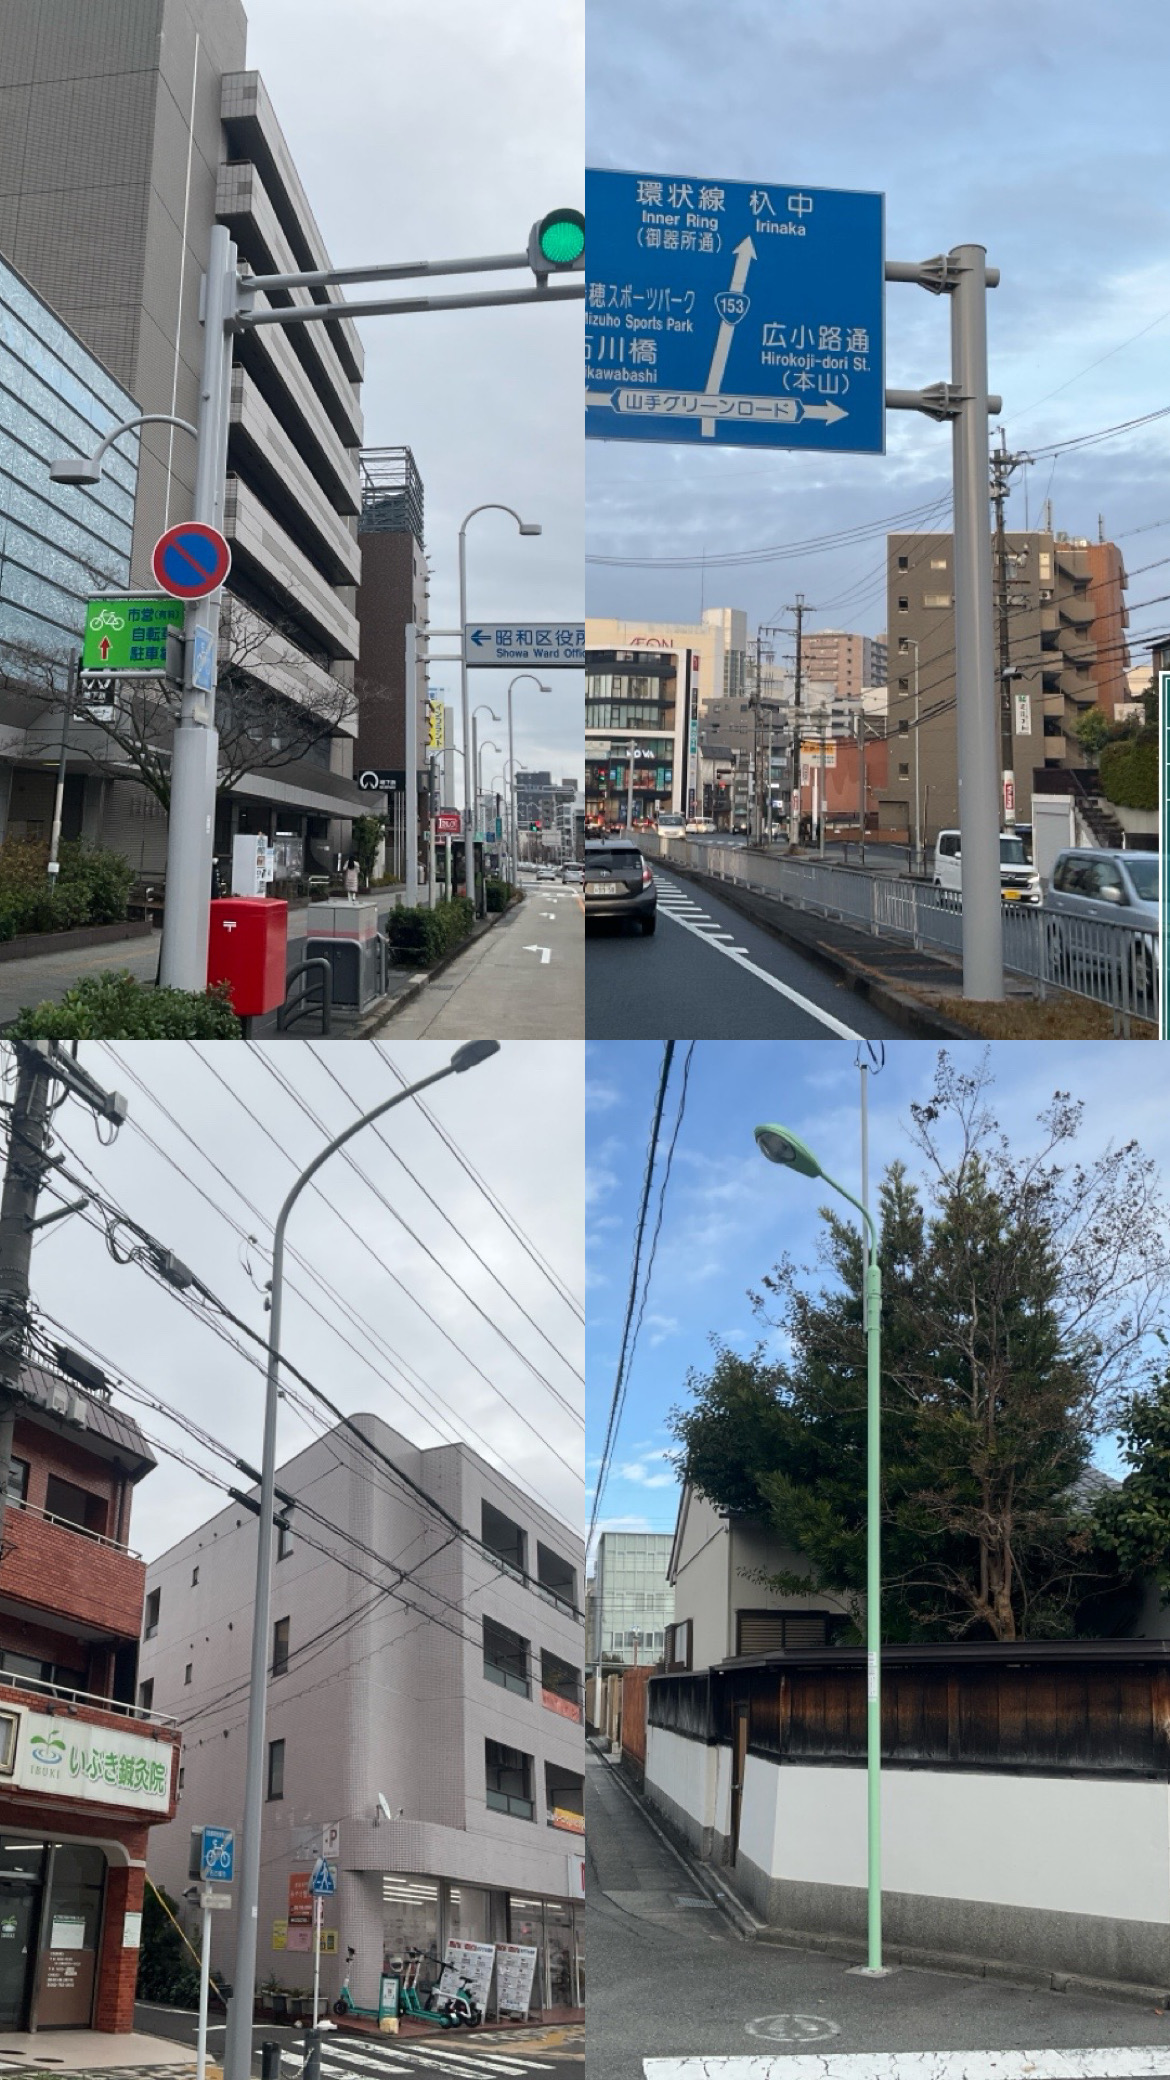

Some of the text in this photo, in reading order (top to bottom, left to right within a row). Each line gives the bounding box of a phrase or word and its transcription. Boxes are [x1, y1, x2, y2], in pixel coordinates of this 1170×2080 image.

[636, 180, 726, 212] 環状線
[749, 190, 814, 218] 杁中
[642, 210, 719, 231] Inner Ring
[756, 219, 806, 236] Irinaka
[585, 282, 696, 314] 穂スポーツパーク
[720, 297, 744, 314] 153
[625, 315, 663, 333] Sports
[666, 317, 694, 333] Park
[762, 322, 869, 354] 広小路通
[761, 351, 871, 372] Hirokoji-dori St.
[782, 370, 851, 396] (本山)
[626, 393, 790, 417] 山手グリーンロード
[496, 648, 529, 659] Showa
[533, 648, 559, 659] Ward
[30, 1765, 61, 1779] IBUKI
[68, 1745, 167, 1795] いぶき鍼灸院
